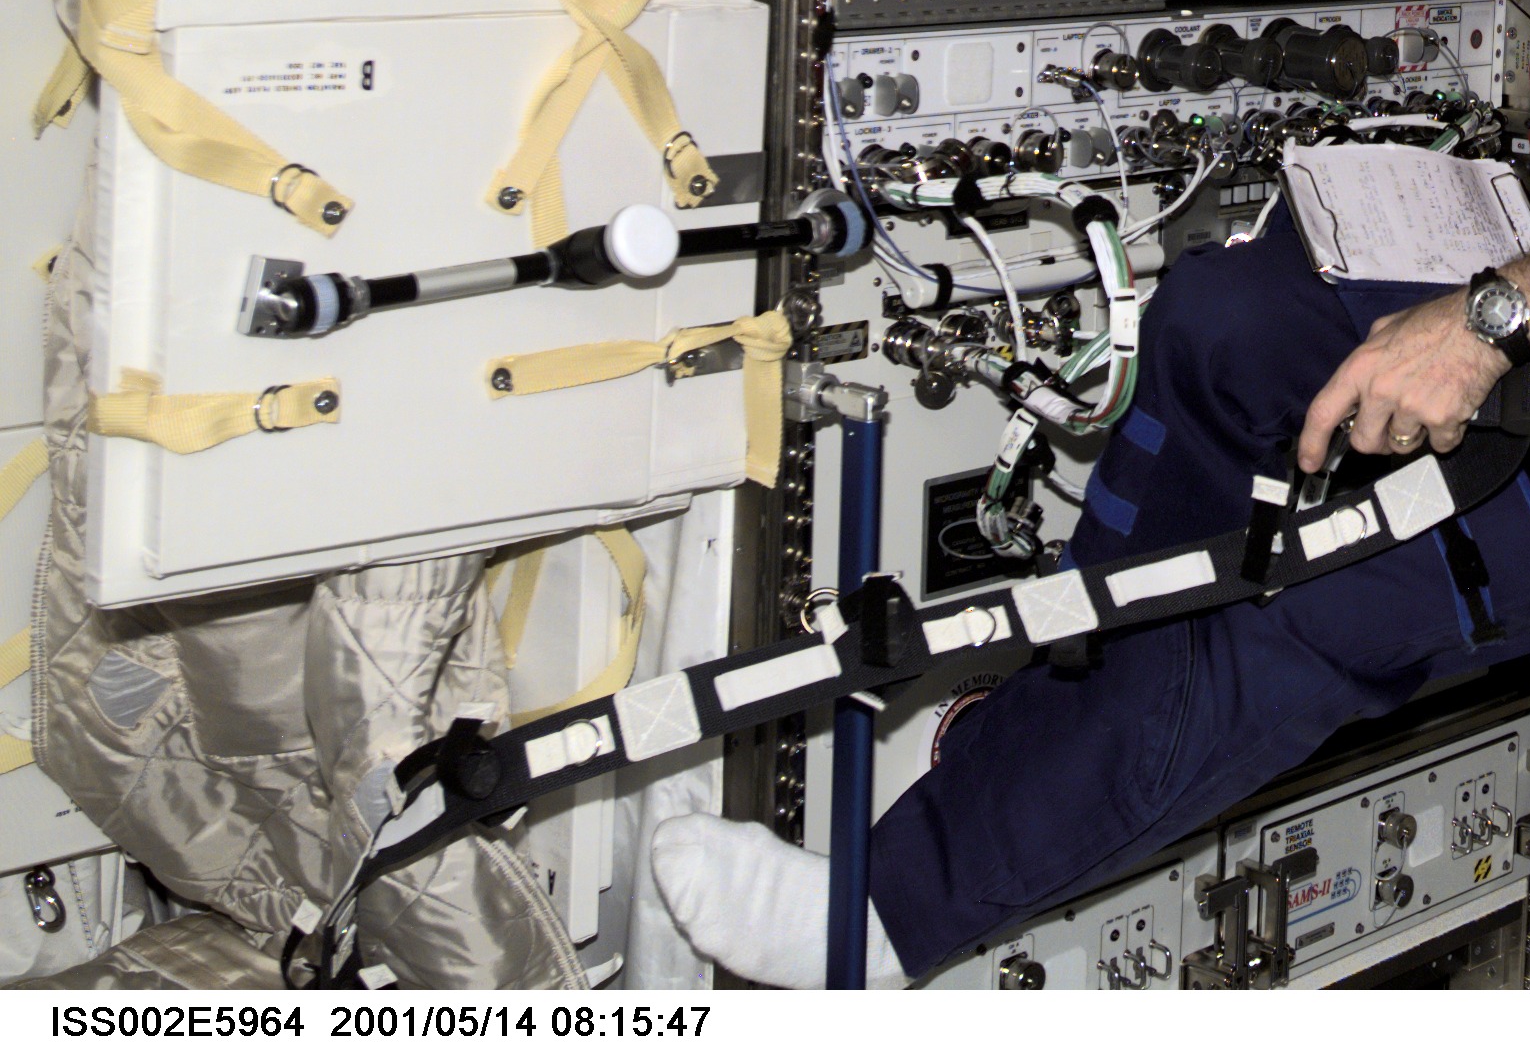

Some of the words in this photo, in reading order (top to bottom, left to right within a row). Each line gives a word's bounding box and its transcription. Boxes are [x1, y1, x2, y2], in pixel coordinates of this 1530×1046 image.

[1285, 818, 1314, 835] REMOTE
[1285, 828, 1315, 845] TRIAXIAL
[1284, 837, 1313, 854] SENSOR
[1286, 878, 1333, 910] SAMS-II
